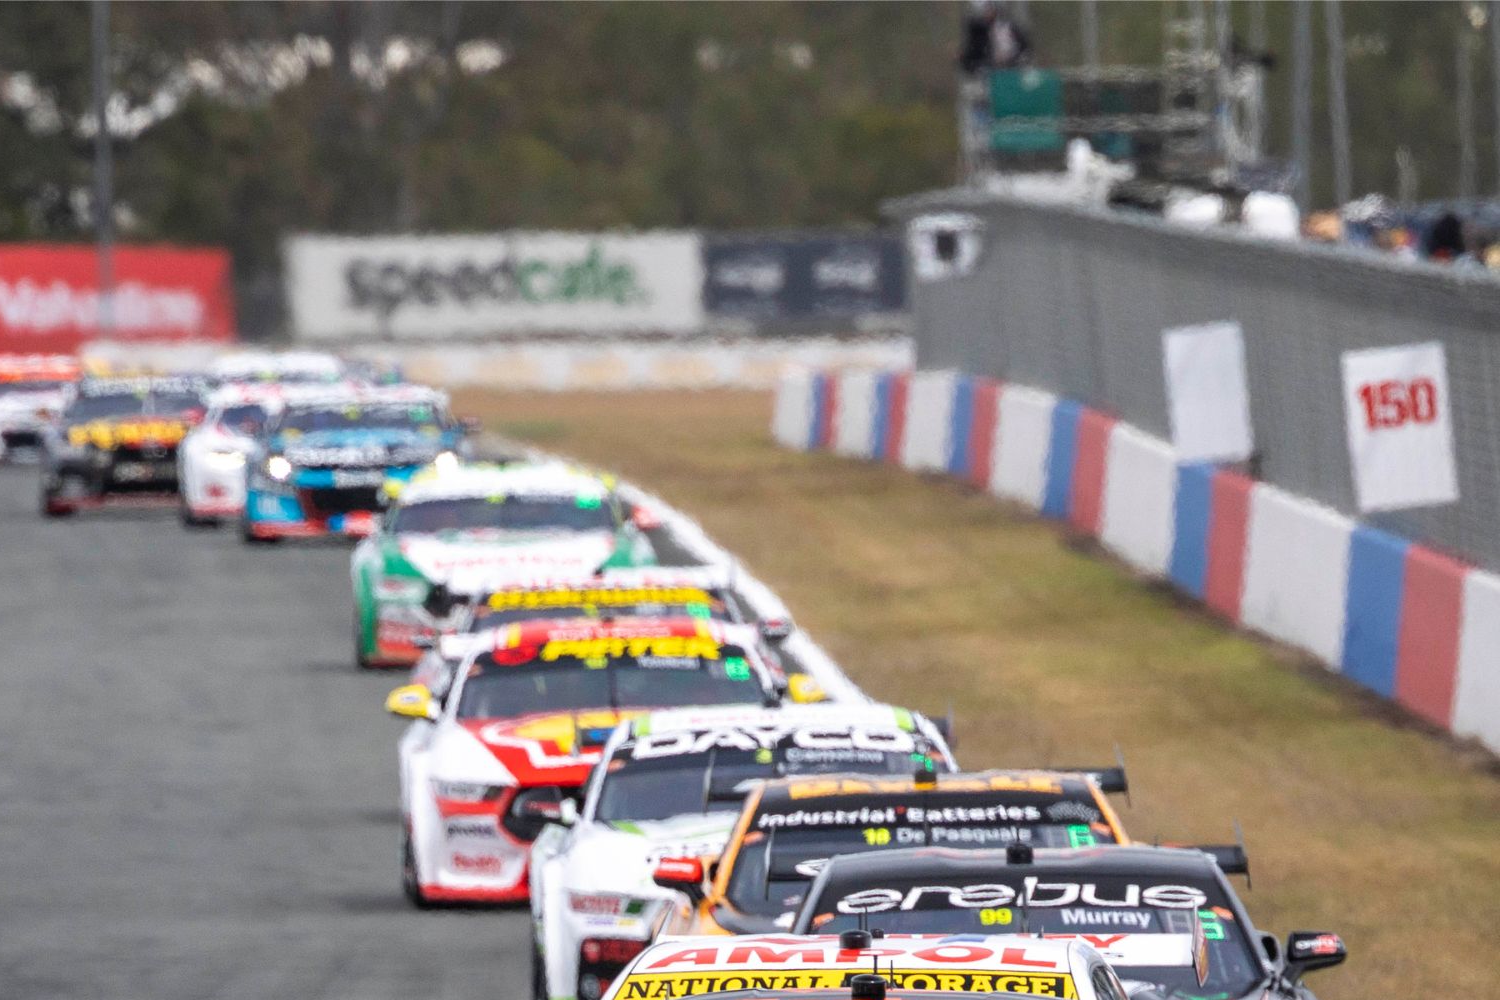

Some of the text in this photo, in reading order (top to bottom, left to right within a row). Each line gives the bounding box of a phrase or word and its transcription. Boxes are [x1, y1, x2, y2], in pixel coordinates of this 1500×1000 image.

[1358, 376, 1437, 430] 150
[632, 727, 915, 760] DAYCO
[758, 804, 1040, 828] Industrial Batteries
[896, 828, 926, 843] De
[932, 826, 1032, 844] Pasquale
[837, 876, 1207, 915] erebus
[980, 908, 1152, 929] 99 Murray
[645, 945, 1058, 970] AMPOL
[624, 973, 1057, 1000] NATIONAL TORAGE
